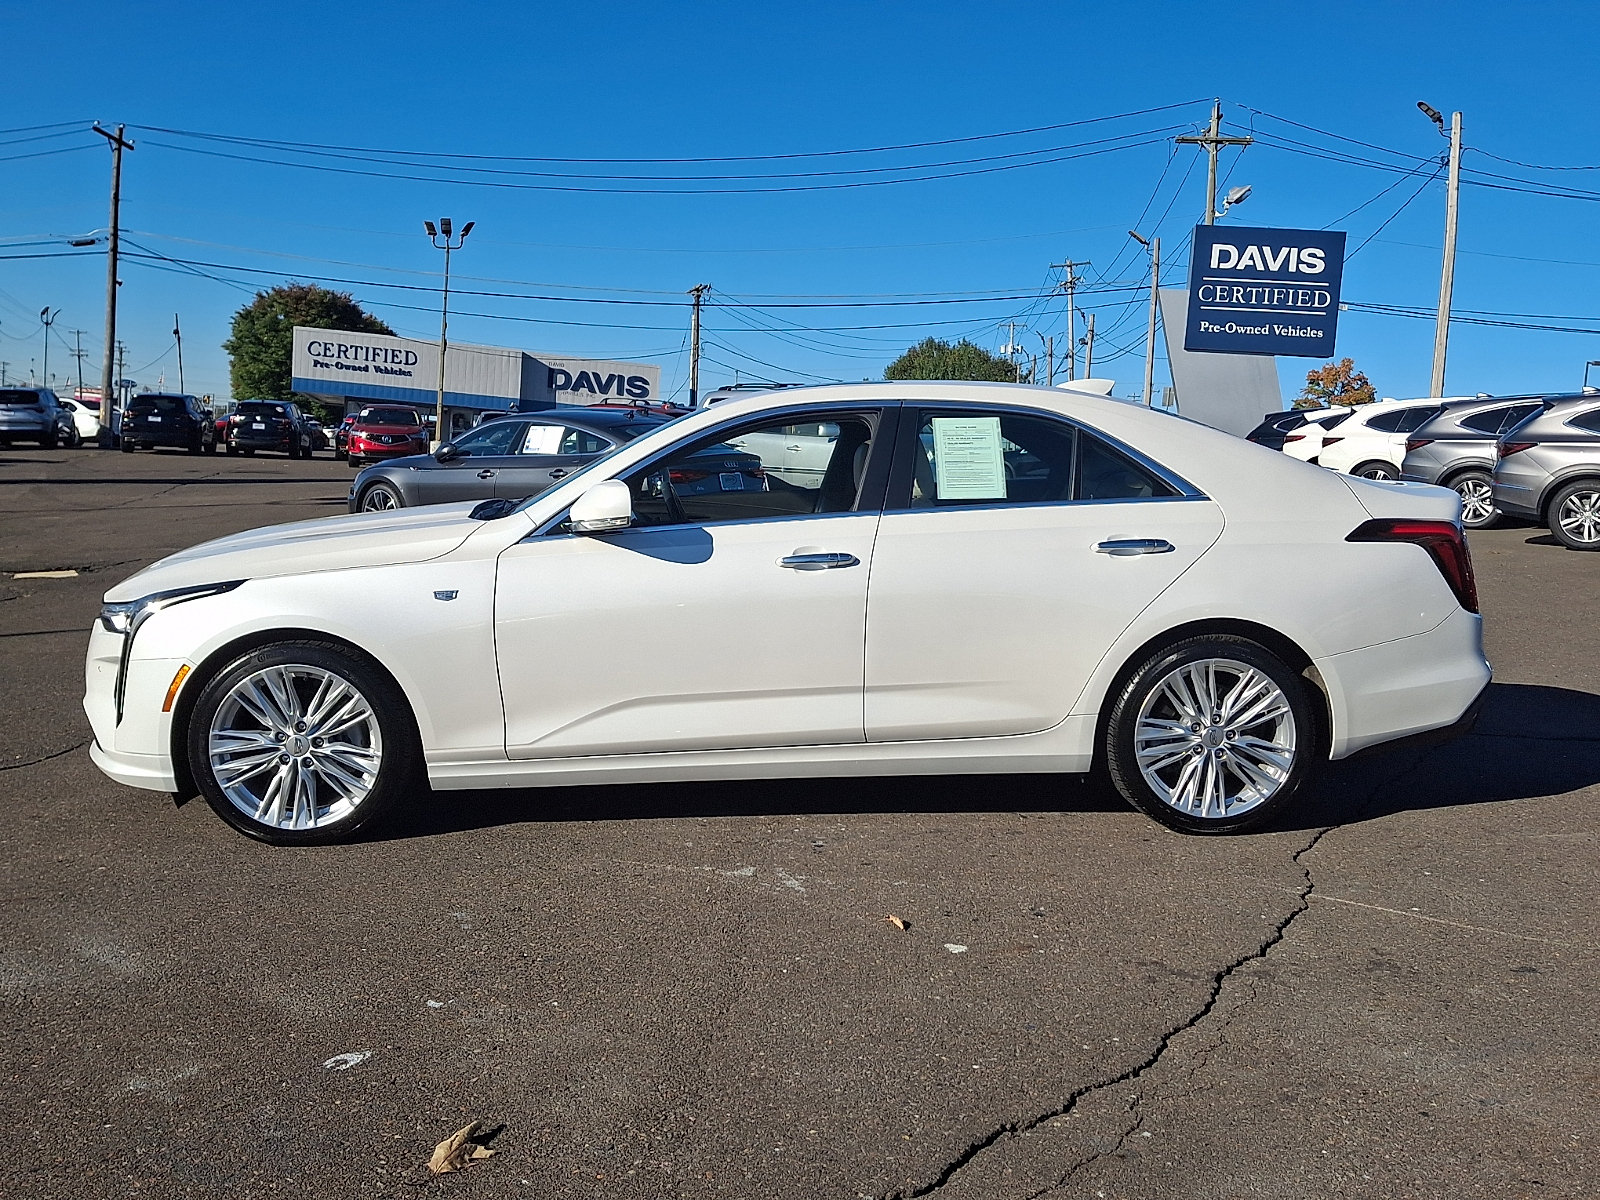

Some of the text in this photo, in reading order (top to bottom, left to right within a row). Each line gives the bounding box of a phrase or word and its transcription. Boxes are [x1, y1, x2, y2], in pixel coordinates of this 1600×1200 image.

[1210, 243, 1326, 274] DAVIS
[1198, 284, 1331, 308] CERTIFIED
[1200, 321, 1324, 338] Pre-Owned Vehicles
[307, 341, 418, 366] CERTIFIED
[312, 359, 412, 377] Pre-Owned Vehicles
[548, 370, 650, 398] DAVIS
